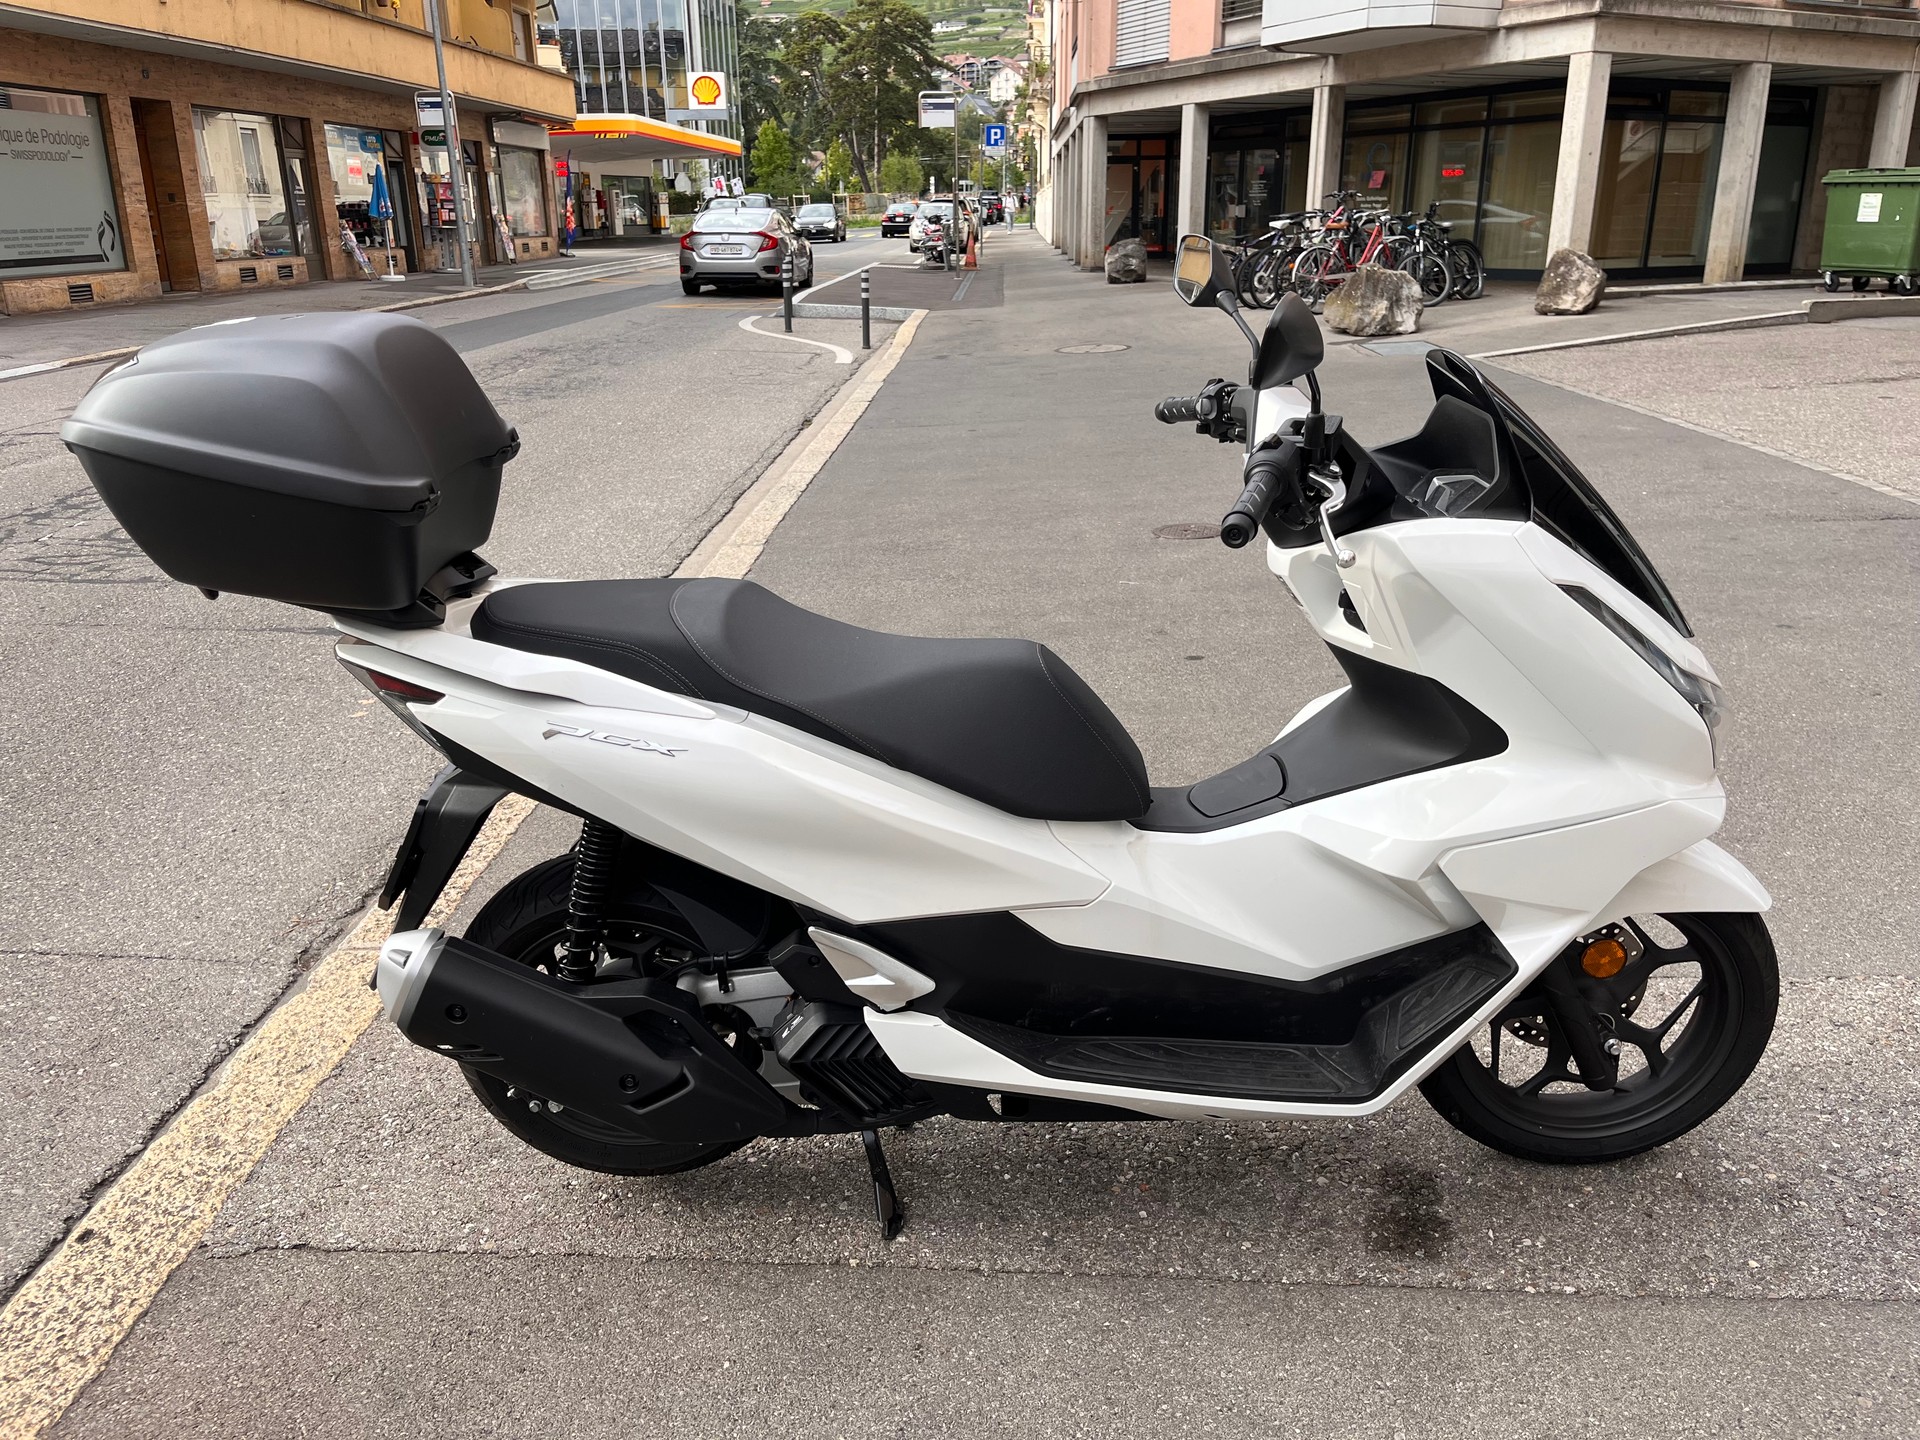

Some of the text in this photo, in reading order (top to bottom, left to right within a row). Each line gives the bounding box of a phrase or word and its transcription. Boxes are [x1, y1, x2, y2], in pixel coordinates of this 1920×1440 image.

[25, 128, 39, 144] de
[40, 128, 90, 150] Podologie
[990, 128, 1001, 145] P
[542, 720, 689, 757] PCX
